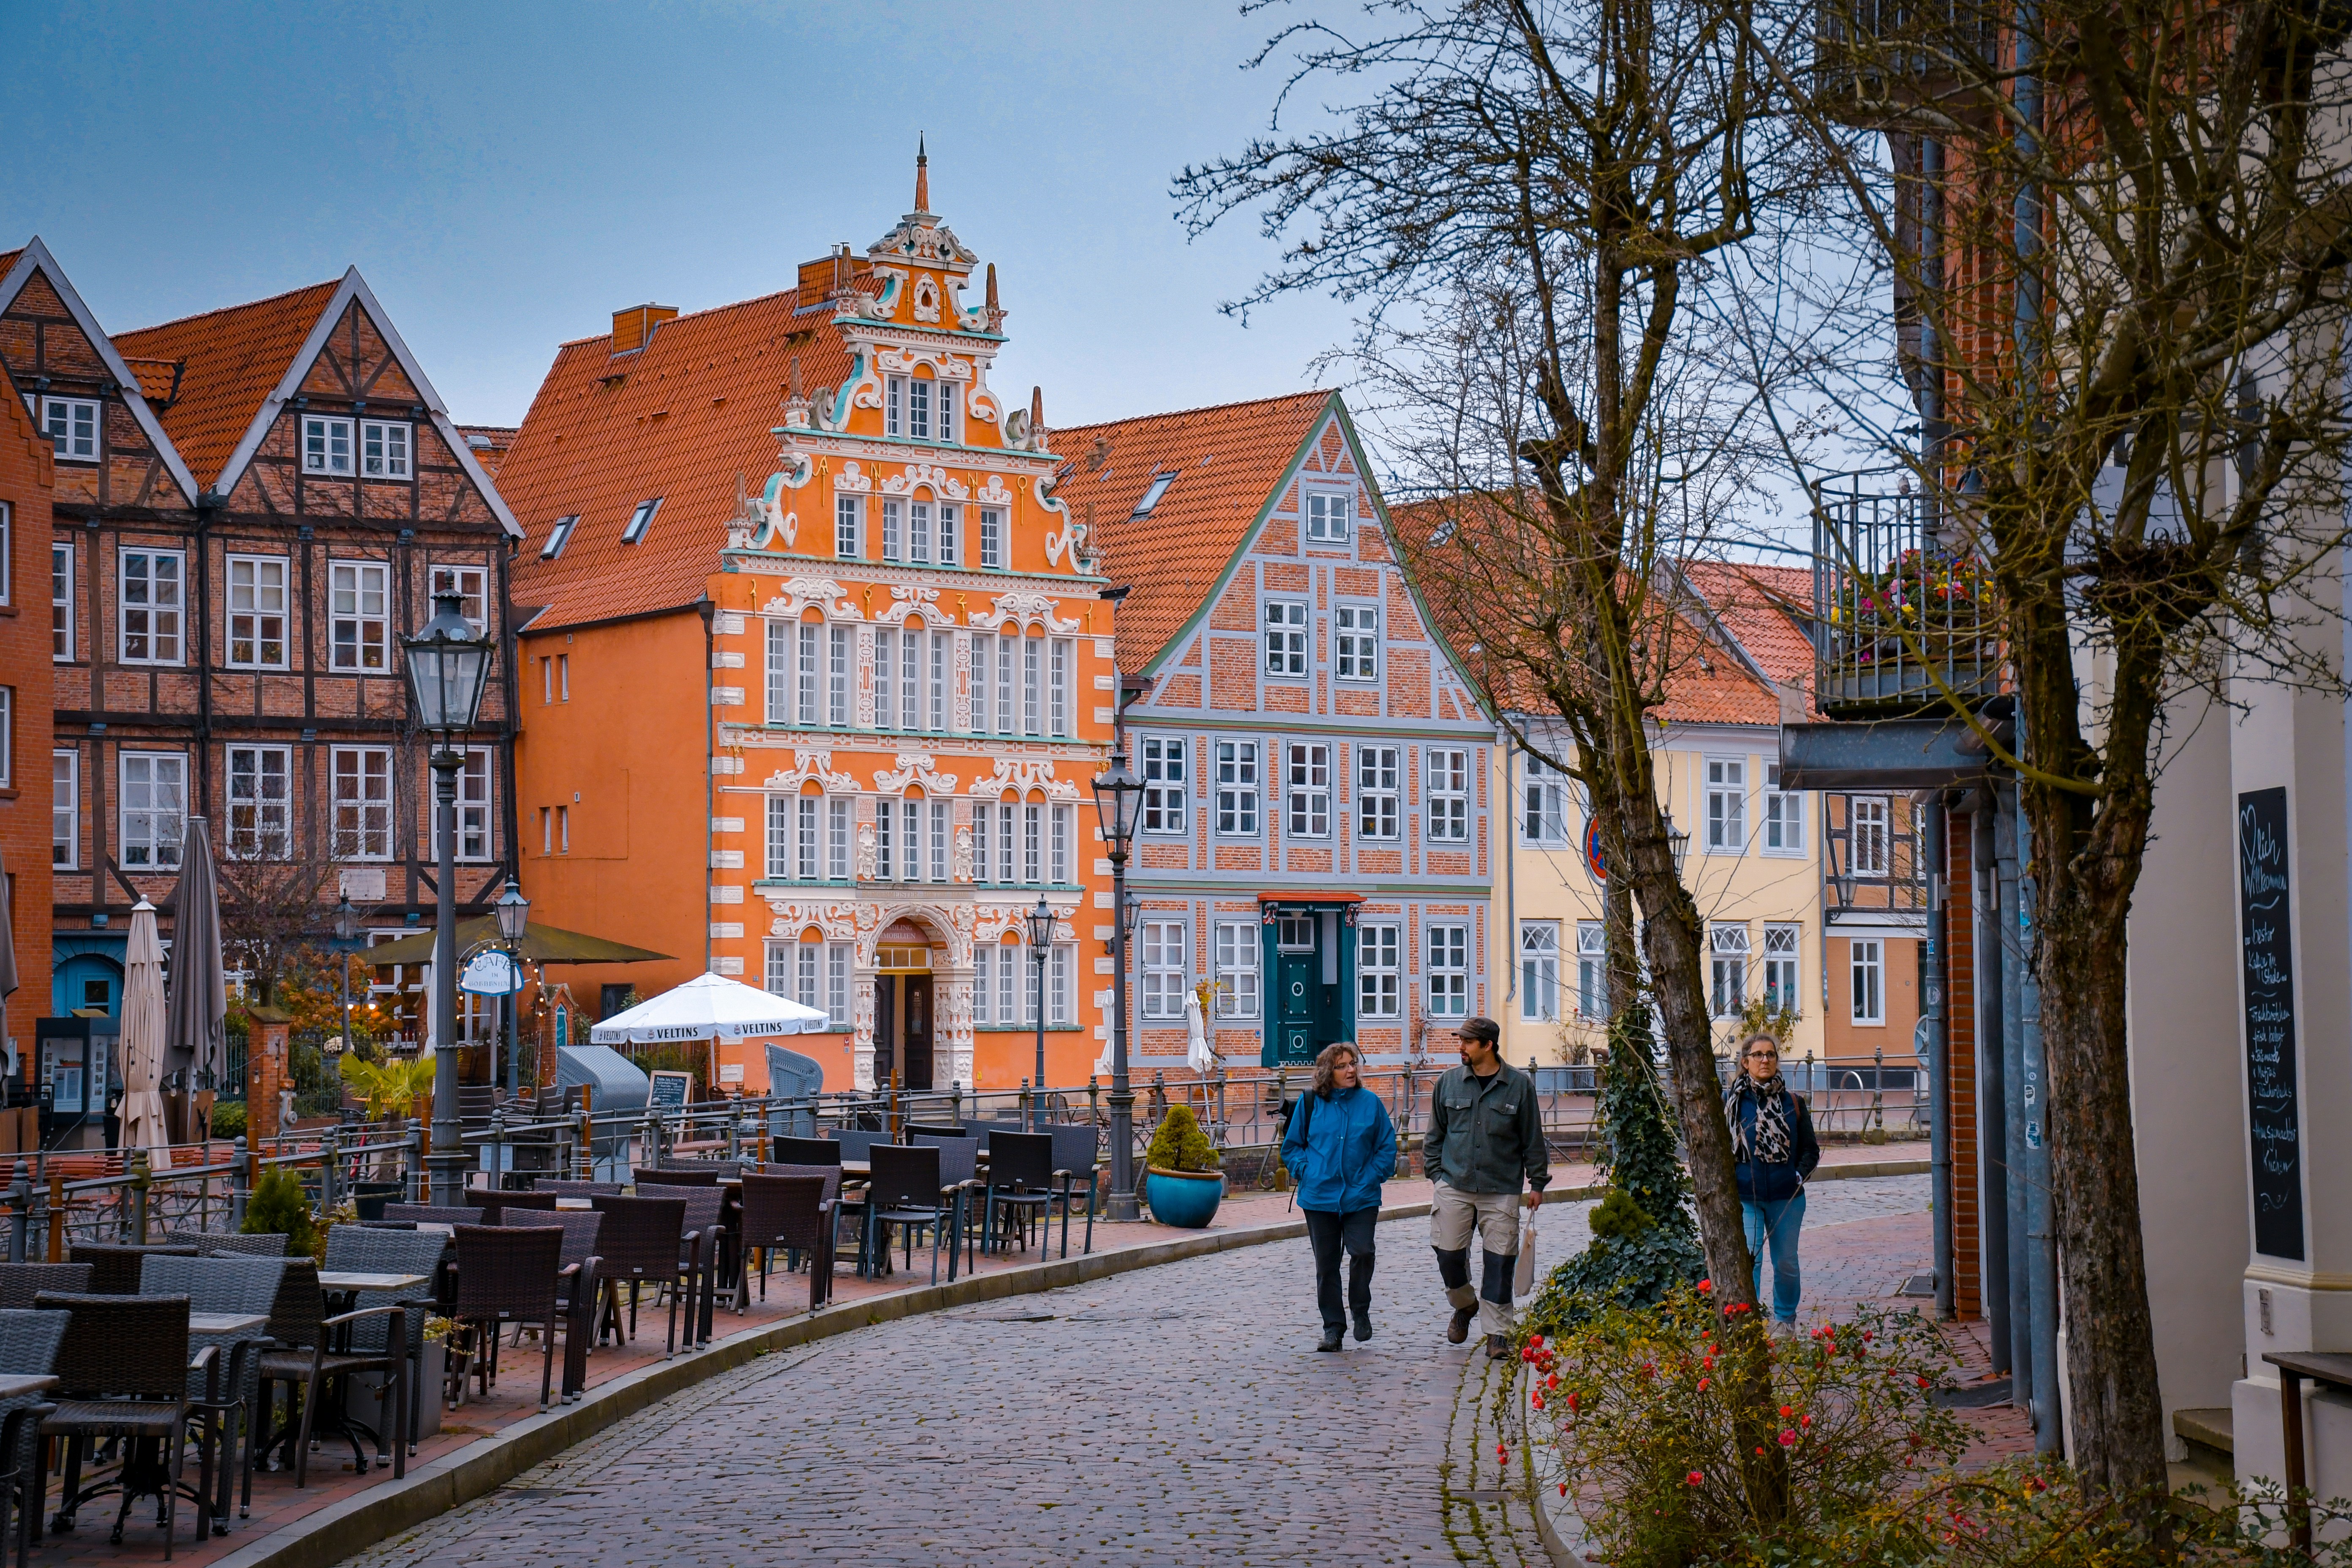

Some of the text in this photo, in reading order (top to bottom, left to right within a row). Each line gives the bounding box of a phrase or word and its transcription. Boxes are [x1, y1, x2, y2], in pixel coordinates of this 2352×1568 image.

[2243, 856, 2287, 899] Willkommen
[742, 1022, 782, 1034] VELTINS
[808, 1019, 823, 1029] VELTINS
[604, 1031, 621, 1040] VELTINS
[657, 1027, 698, 1039] VELTINS
